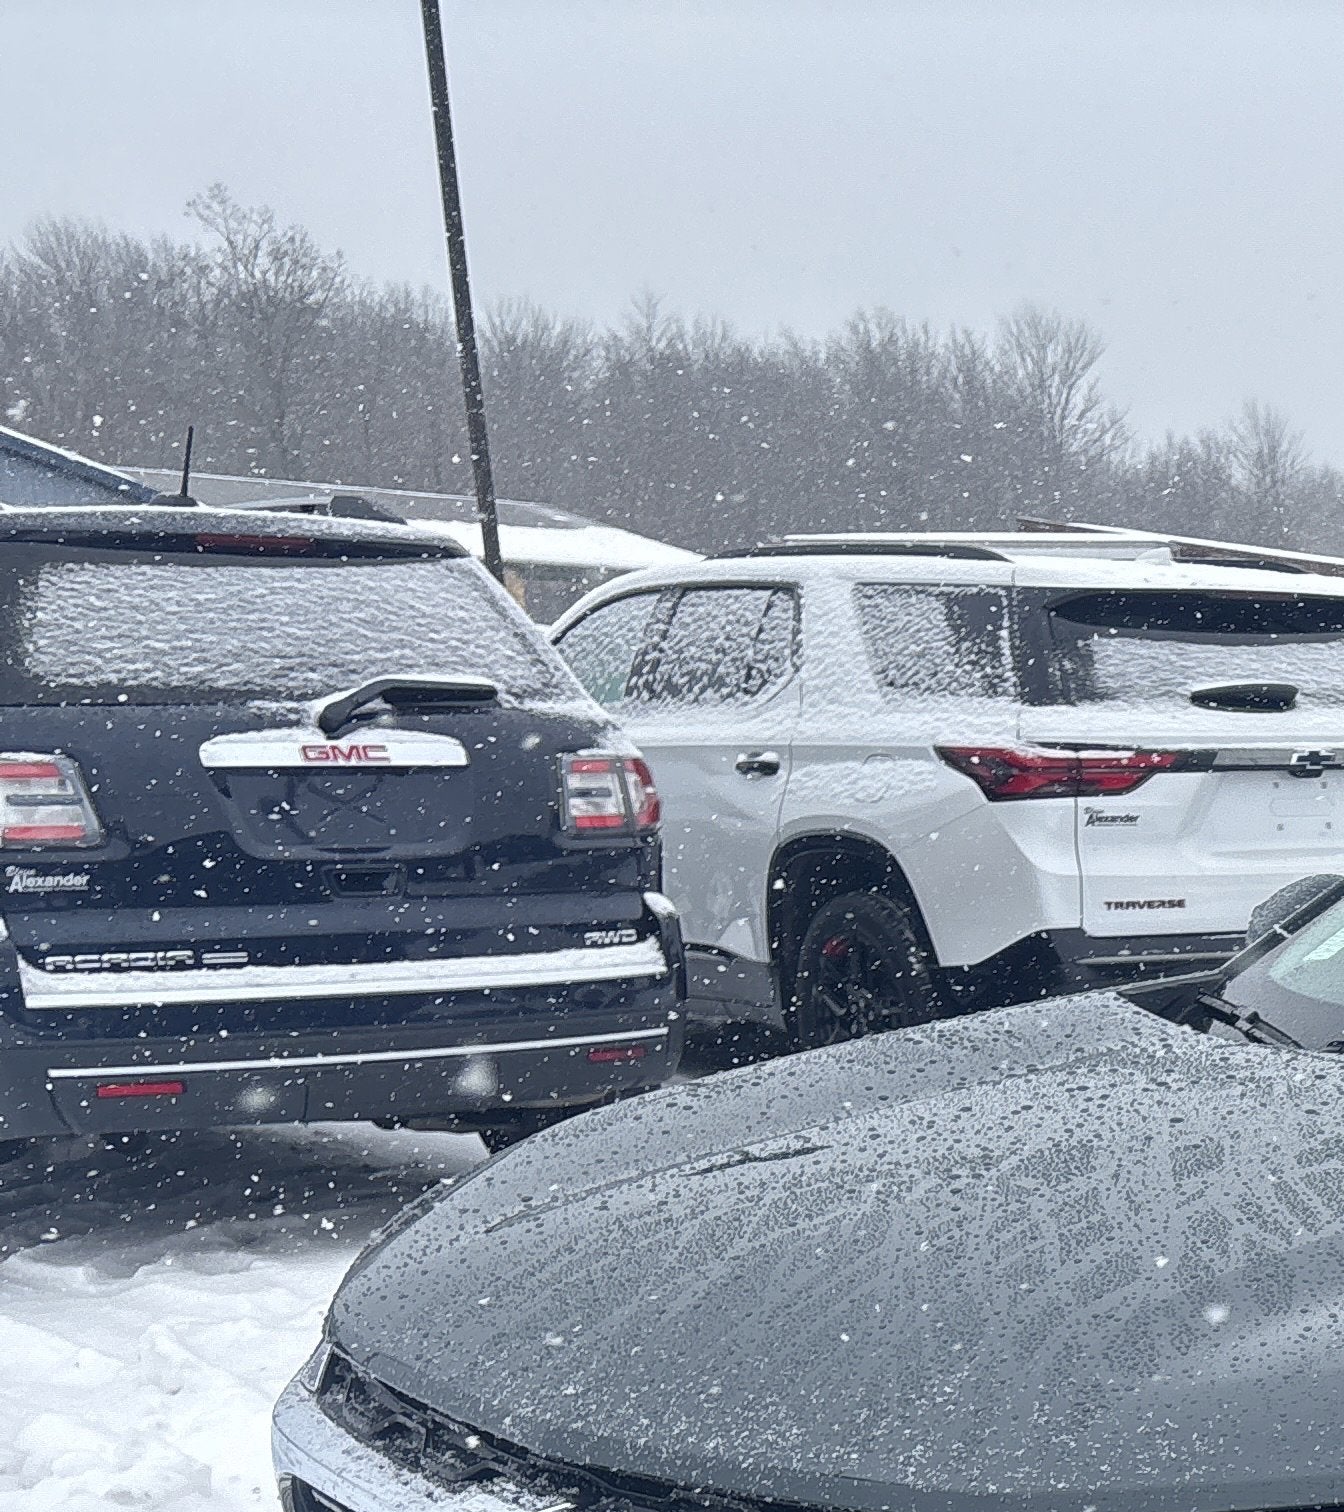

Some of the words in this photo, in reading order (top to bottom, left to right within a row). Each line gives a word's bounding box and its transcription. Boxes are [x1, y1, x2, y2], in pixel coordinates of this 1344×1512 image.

[301, 744, 391, 763] GMC
[9, 872, 91, 893] Alexander
[1104, 899, 1186, 910] TRAVERSE
[584, 929, 638, 945] AWD
